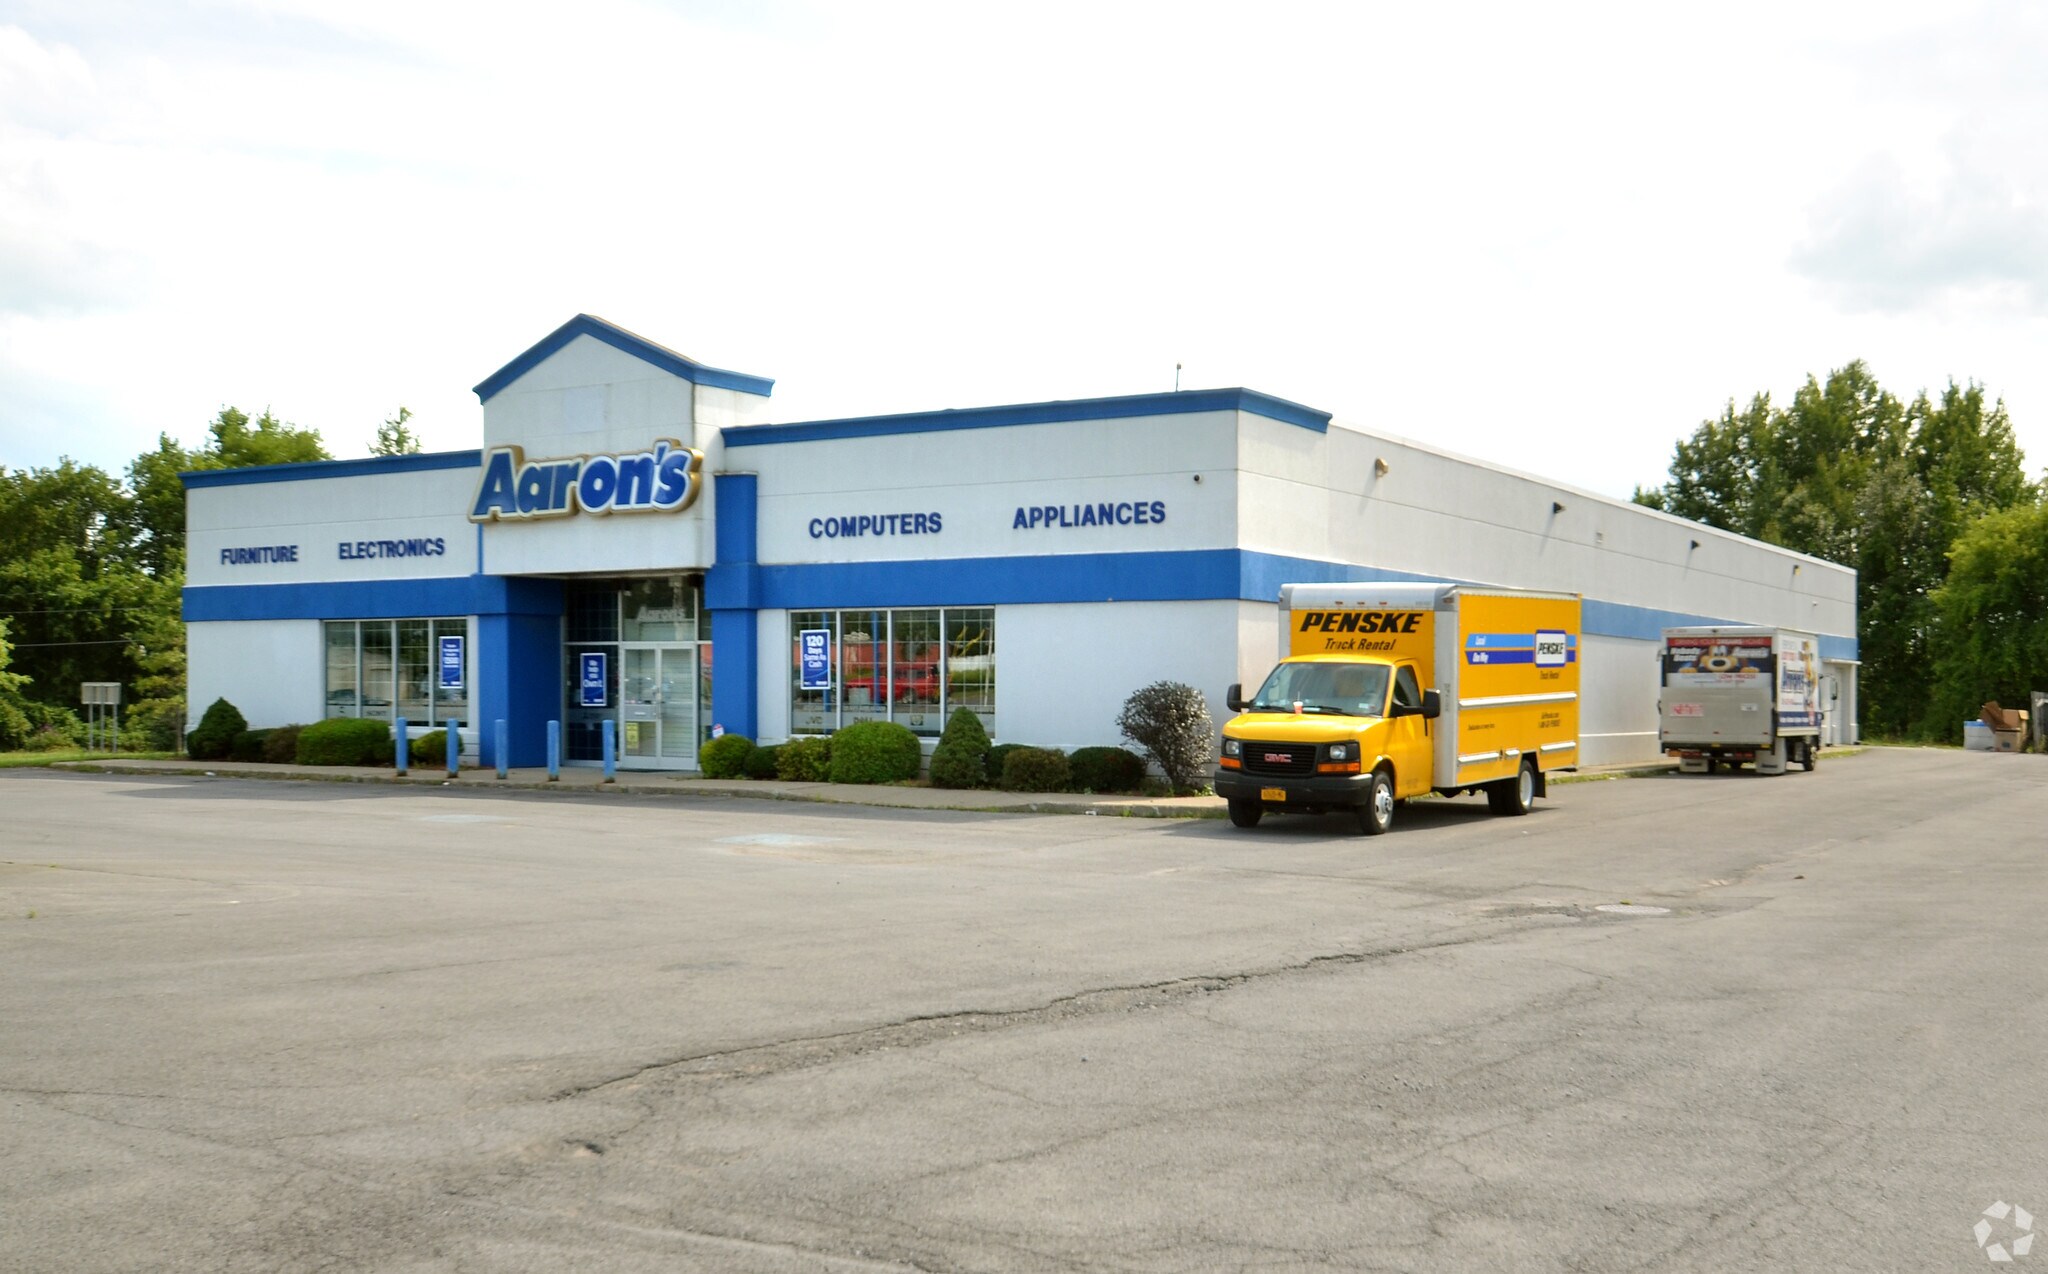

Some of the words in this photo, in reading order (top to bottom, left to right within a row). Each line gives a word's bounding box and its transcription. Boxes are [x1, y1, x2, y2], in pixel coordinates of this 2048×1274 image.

[470, 441, 693, 517] Aaron's
[809, 512, 942, 538] COMPUTERS
[1013, 501, 1165, 529] APPLIANCES
[221, 545, 298, 565] FURNITURE
[338, 538, 444, 559] ELECTRONICS
[1300, 612, 1423, 634] PENSKE
[806, 635, 824, 646] 120
[1325, 637, 1355, 650] Truck
[1358, 638, 1396, 650] Rental
[1538, 642, 1564, 654] PENSKE
[1264, 753, 1292, 762] GMC
